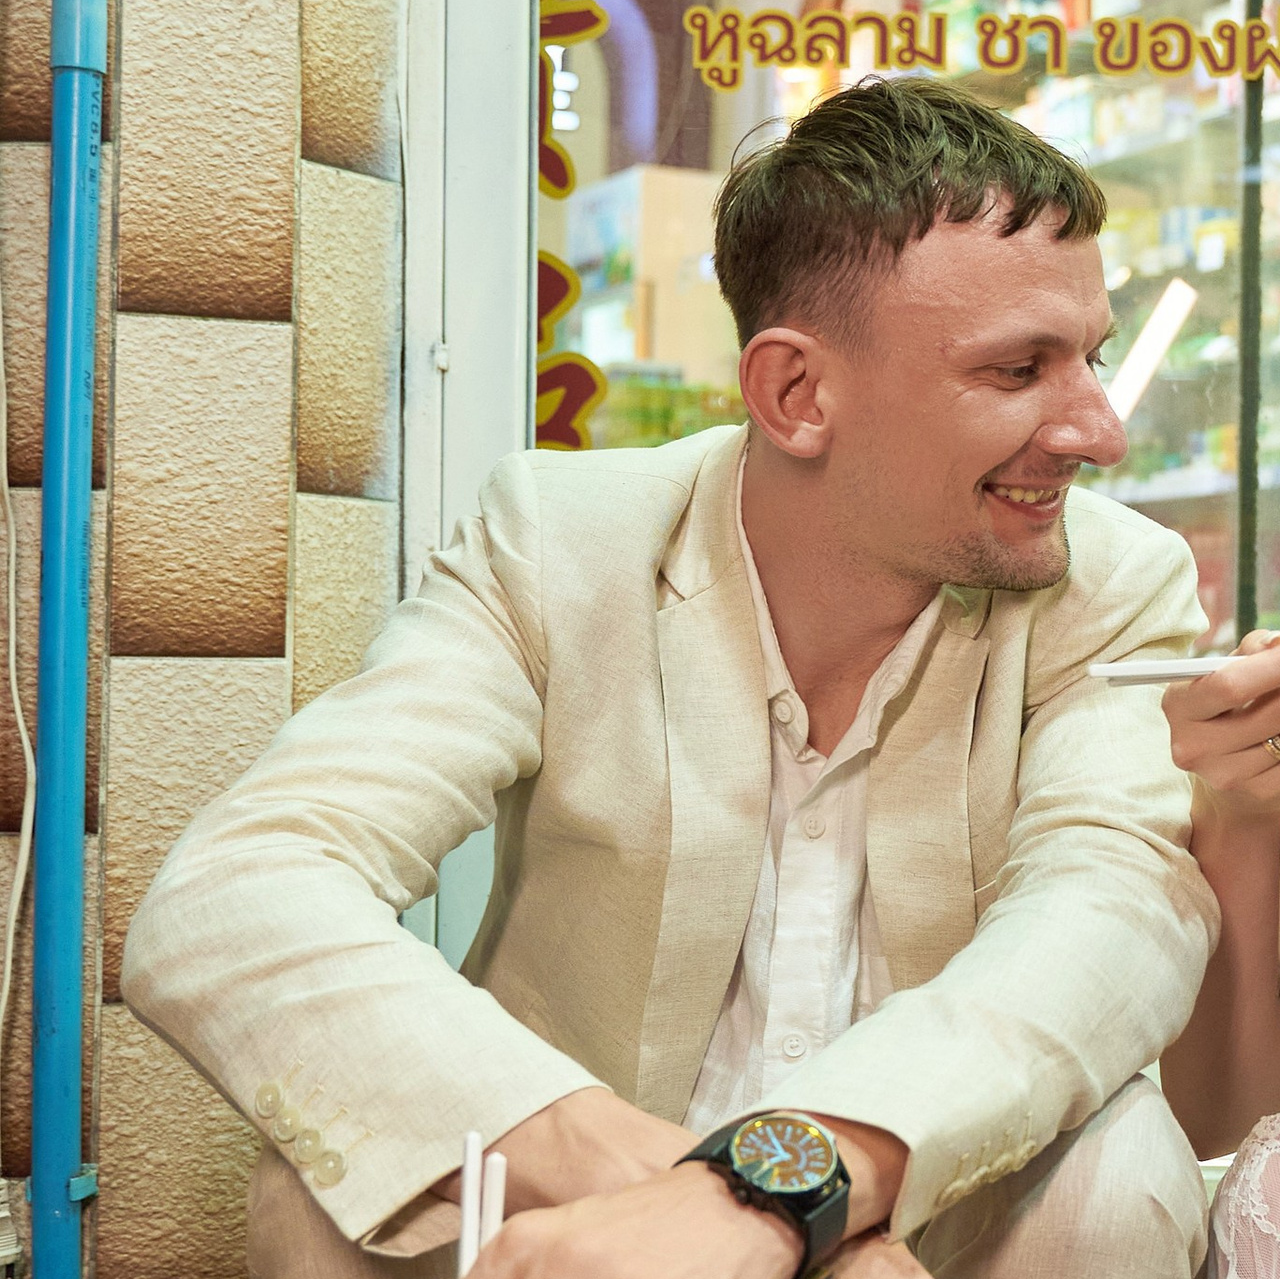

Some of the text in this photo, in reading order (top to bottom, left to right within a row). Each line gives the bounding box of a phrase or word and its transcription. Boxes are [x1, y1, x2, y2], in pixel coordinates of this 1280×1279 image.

[687, 6, 948, 91] หูฉลาม
[976, 13, 1065, 74] ชา
